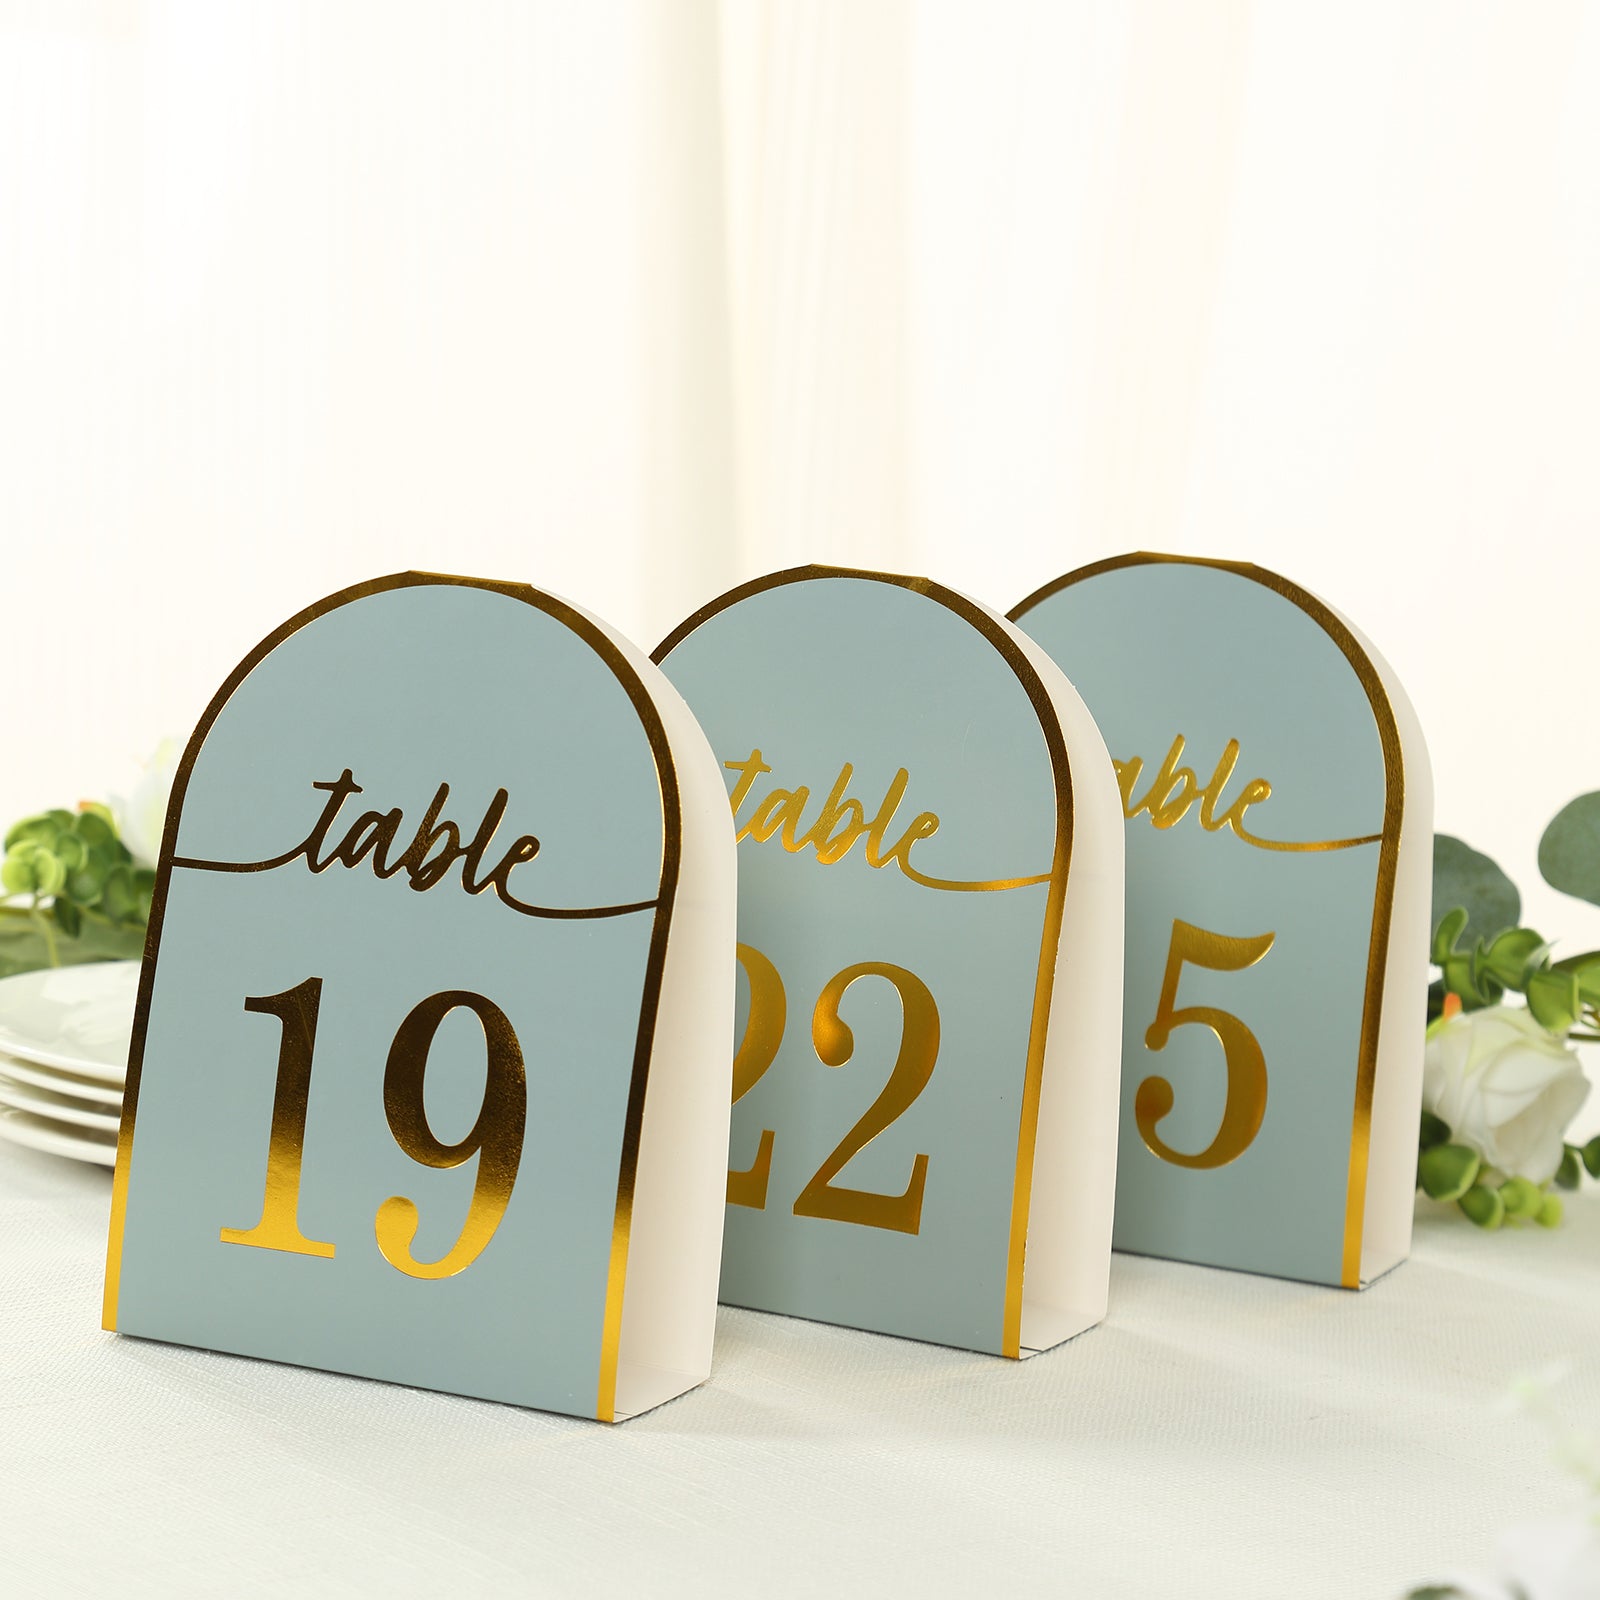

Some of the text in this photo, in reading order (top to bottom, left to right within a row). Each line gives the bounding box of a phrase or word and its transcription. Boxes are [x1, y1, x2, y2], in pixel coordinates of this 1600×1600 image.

[300, 768, 542, 912] table
[724, 748, 940, 886] table
[1111, 733, 1272, 845] ble
[219, 976, 527, 1280] 19
